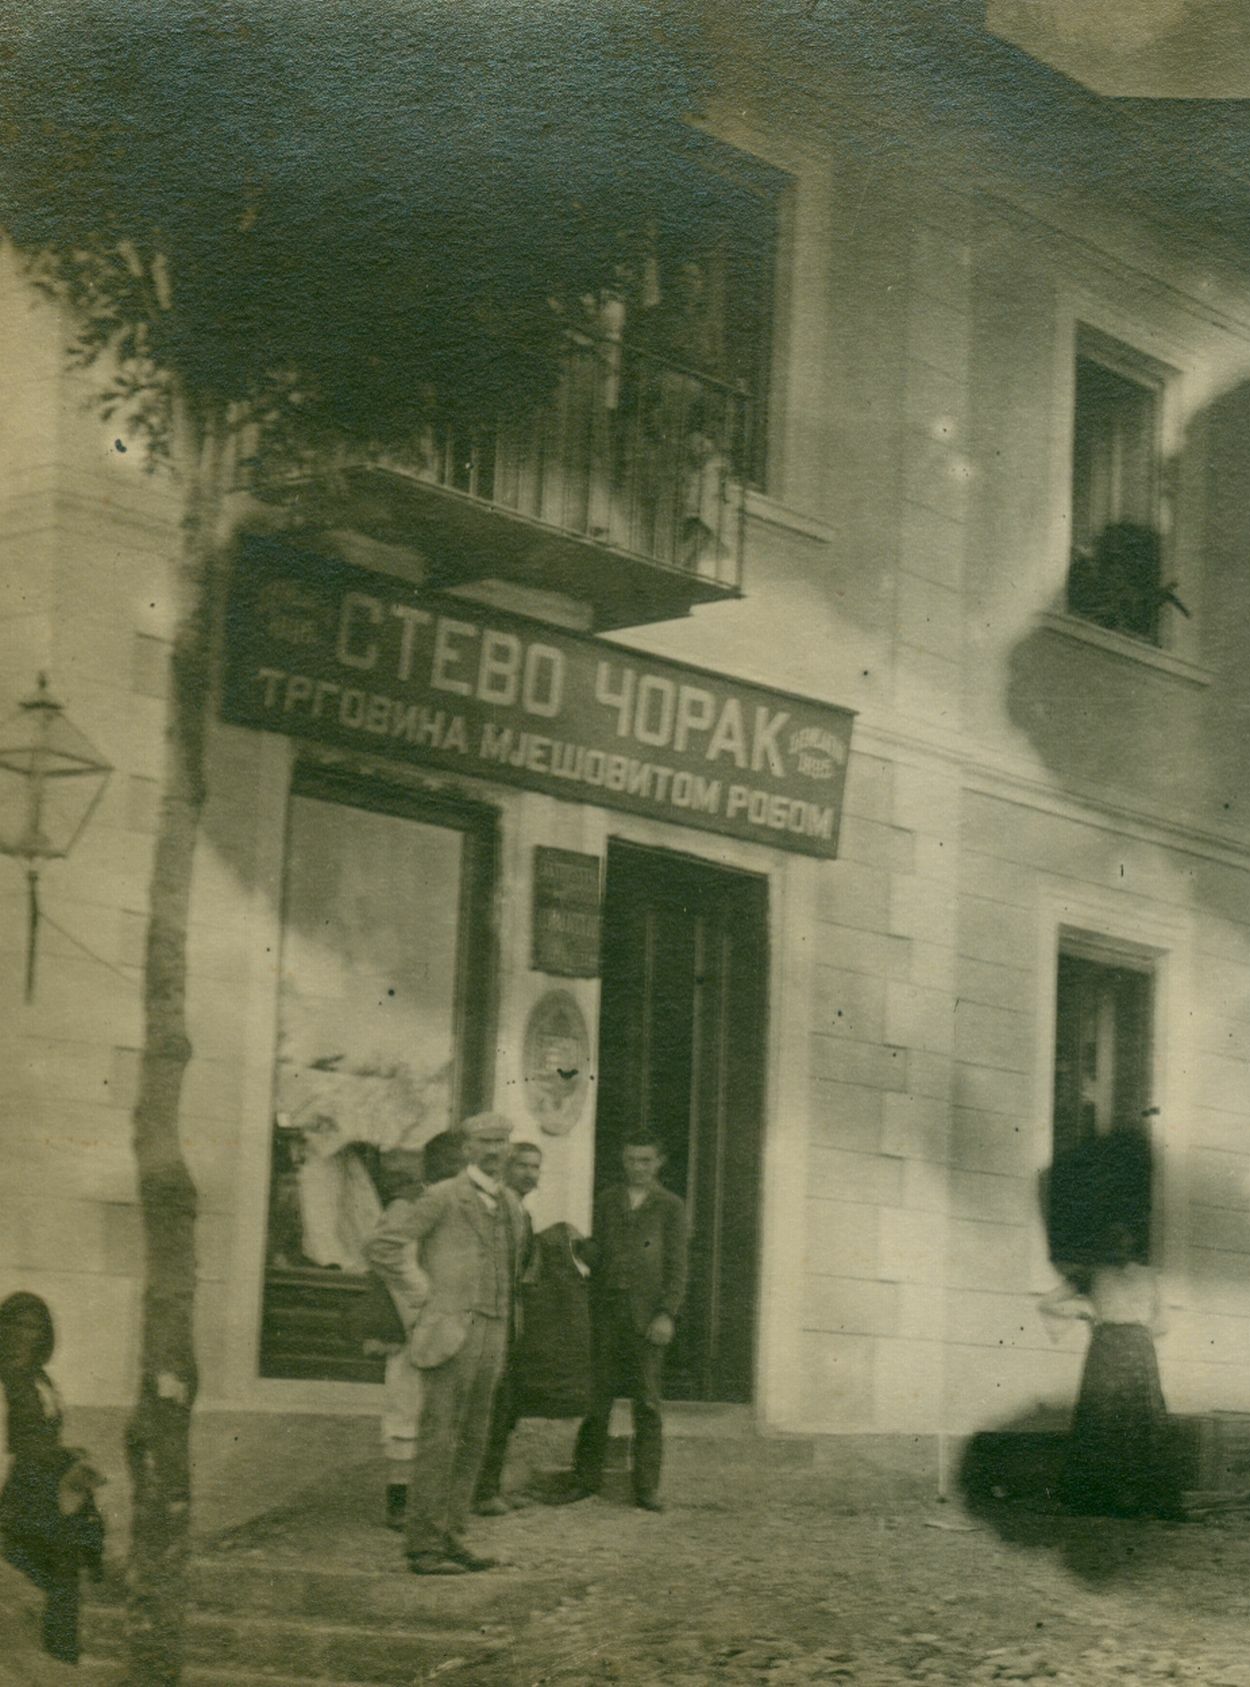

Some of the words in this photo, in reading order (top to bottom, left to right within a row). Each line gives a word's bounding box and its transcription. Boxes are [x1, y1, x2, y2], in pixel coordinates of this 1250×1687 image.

[257, 666, 468, 754] ТРГОВИНА
[479, 722, 723, 814] МЈЕШОВИТОМ
[725, 784, 836, 840] РОБОМ
[336, 591, 567, 717] СТЕВО
[595, 660, 791, 777] ЧОРАК
